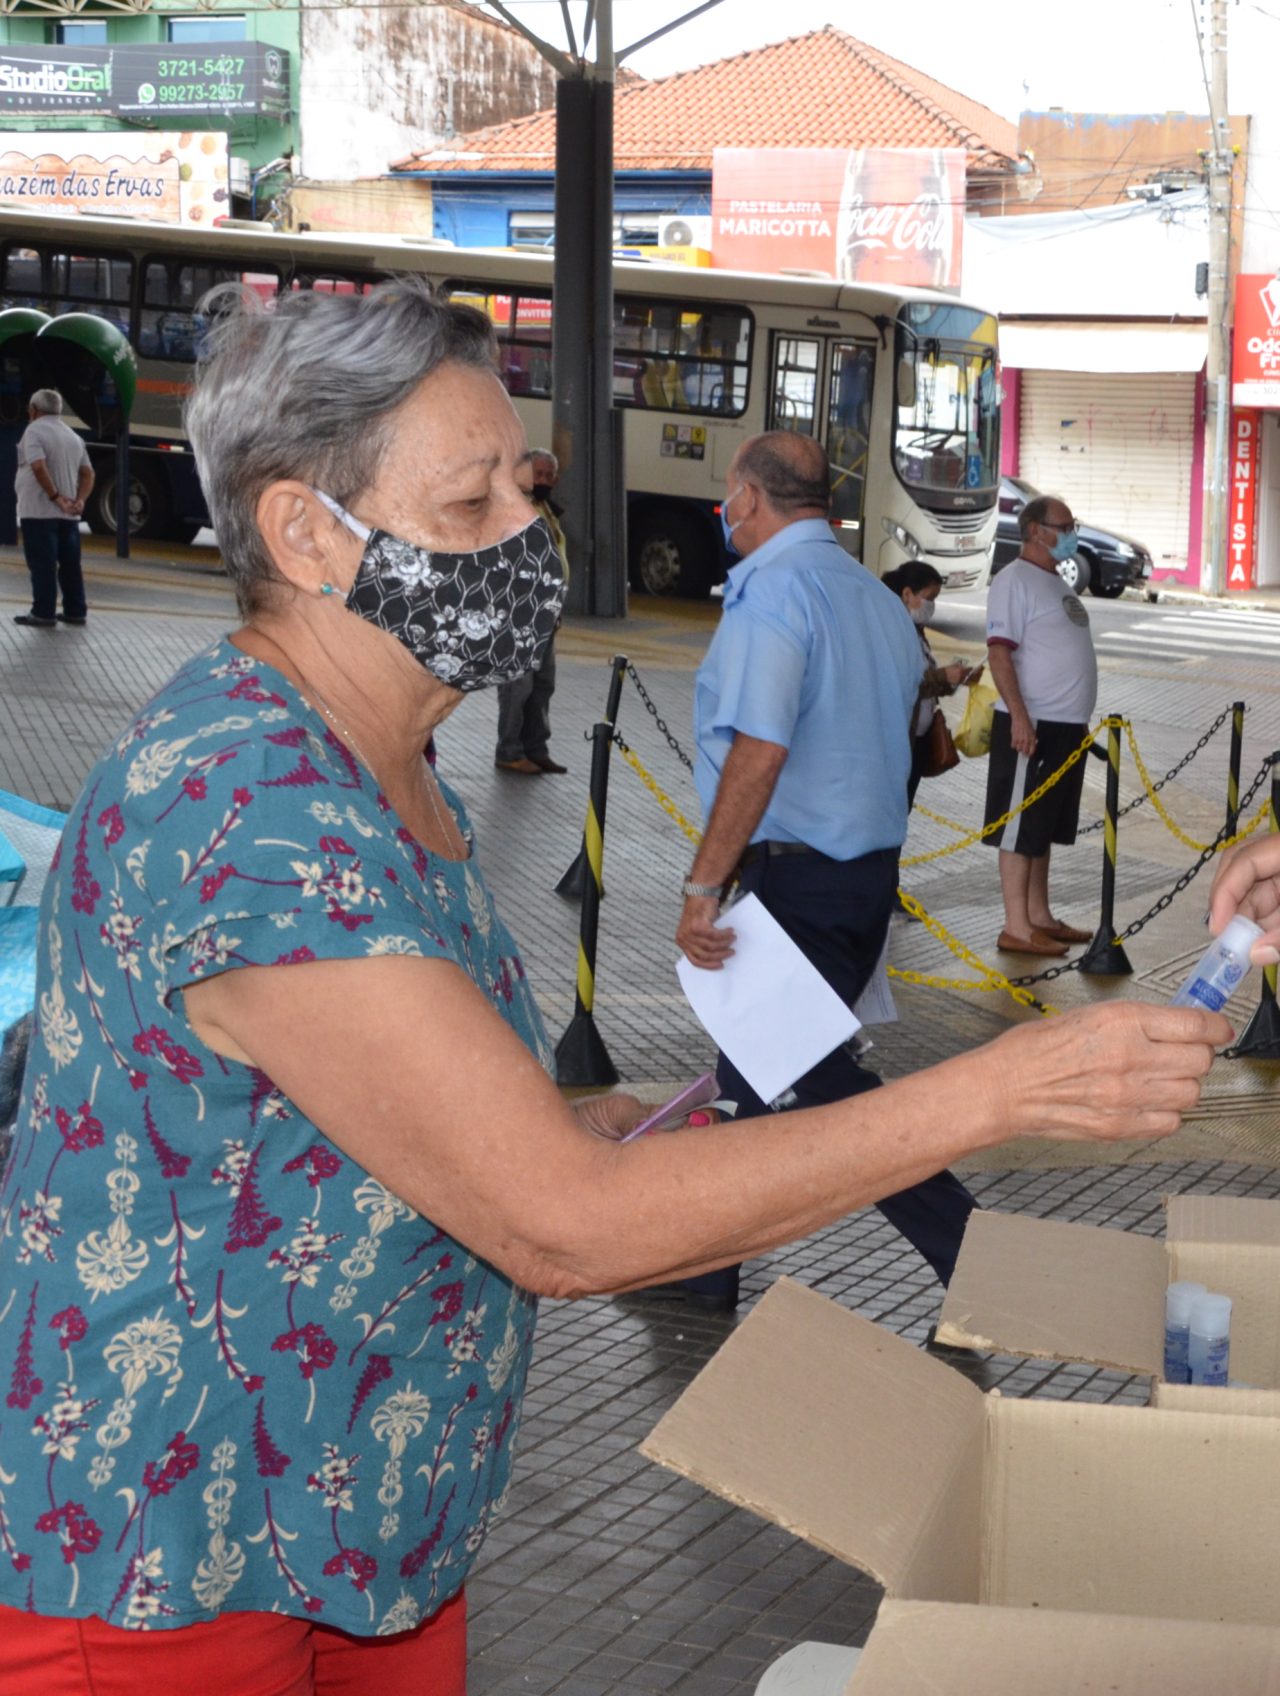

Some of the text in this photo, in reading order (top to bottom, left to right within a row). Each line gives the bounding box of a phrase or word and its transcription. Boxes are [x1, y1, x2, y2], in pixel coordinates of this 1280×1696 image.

[158, 58, 245, 77] 3721-5427
[159, 84, 245, 102] 99273-2957
[0, 163, 164, 197] azém das Ervas
[729, 200, 823, 214] PASTELARIA
[719, 217, 833, 238] MARICOTTA
[1230, 420, 1251, 582] DENTISTA
